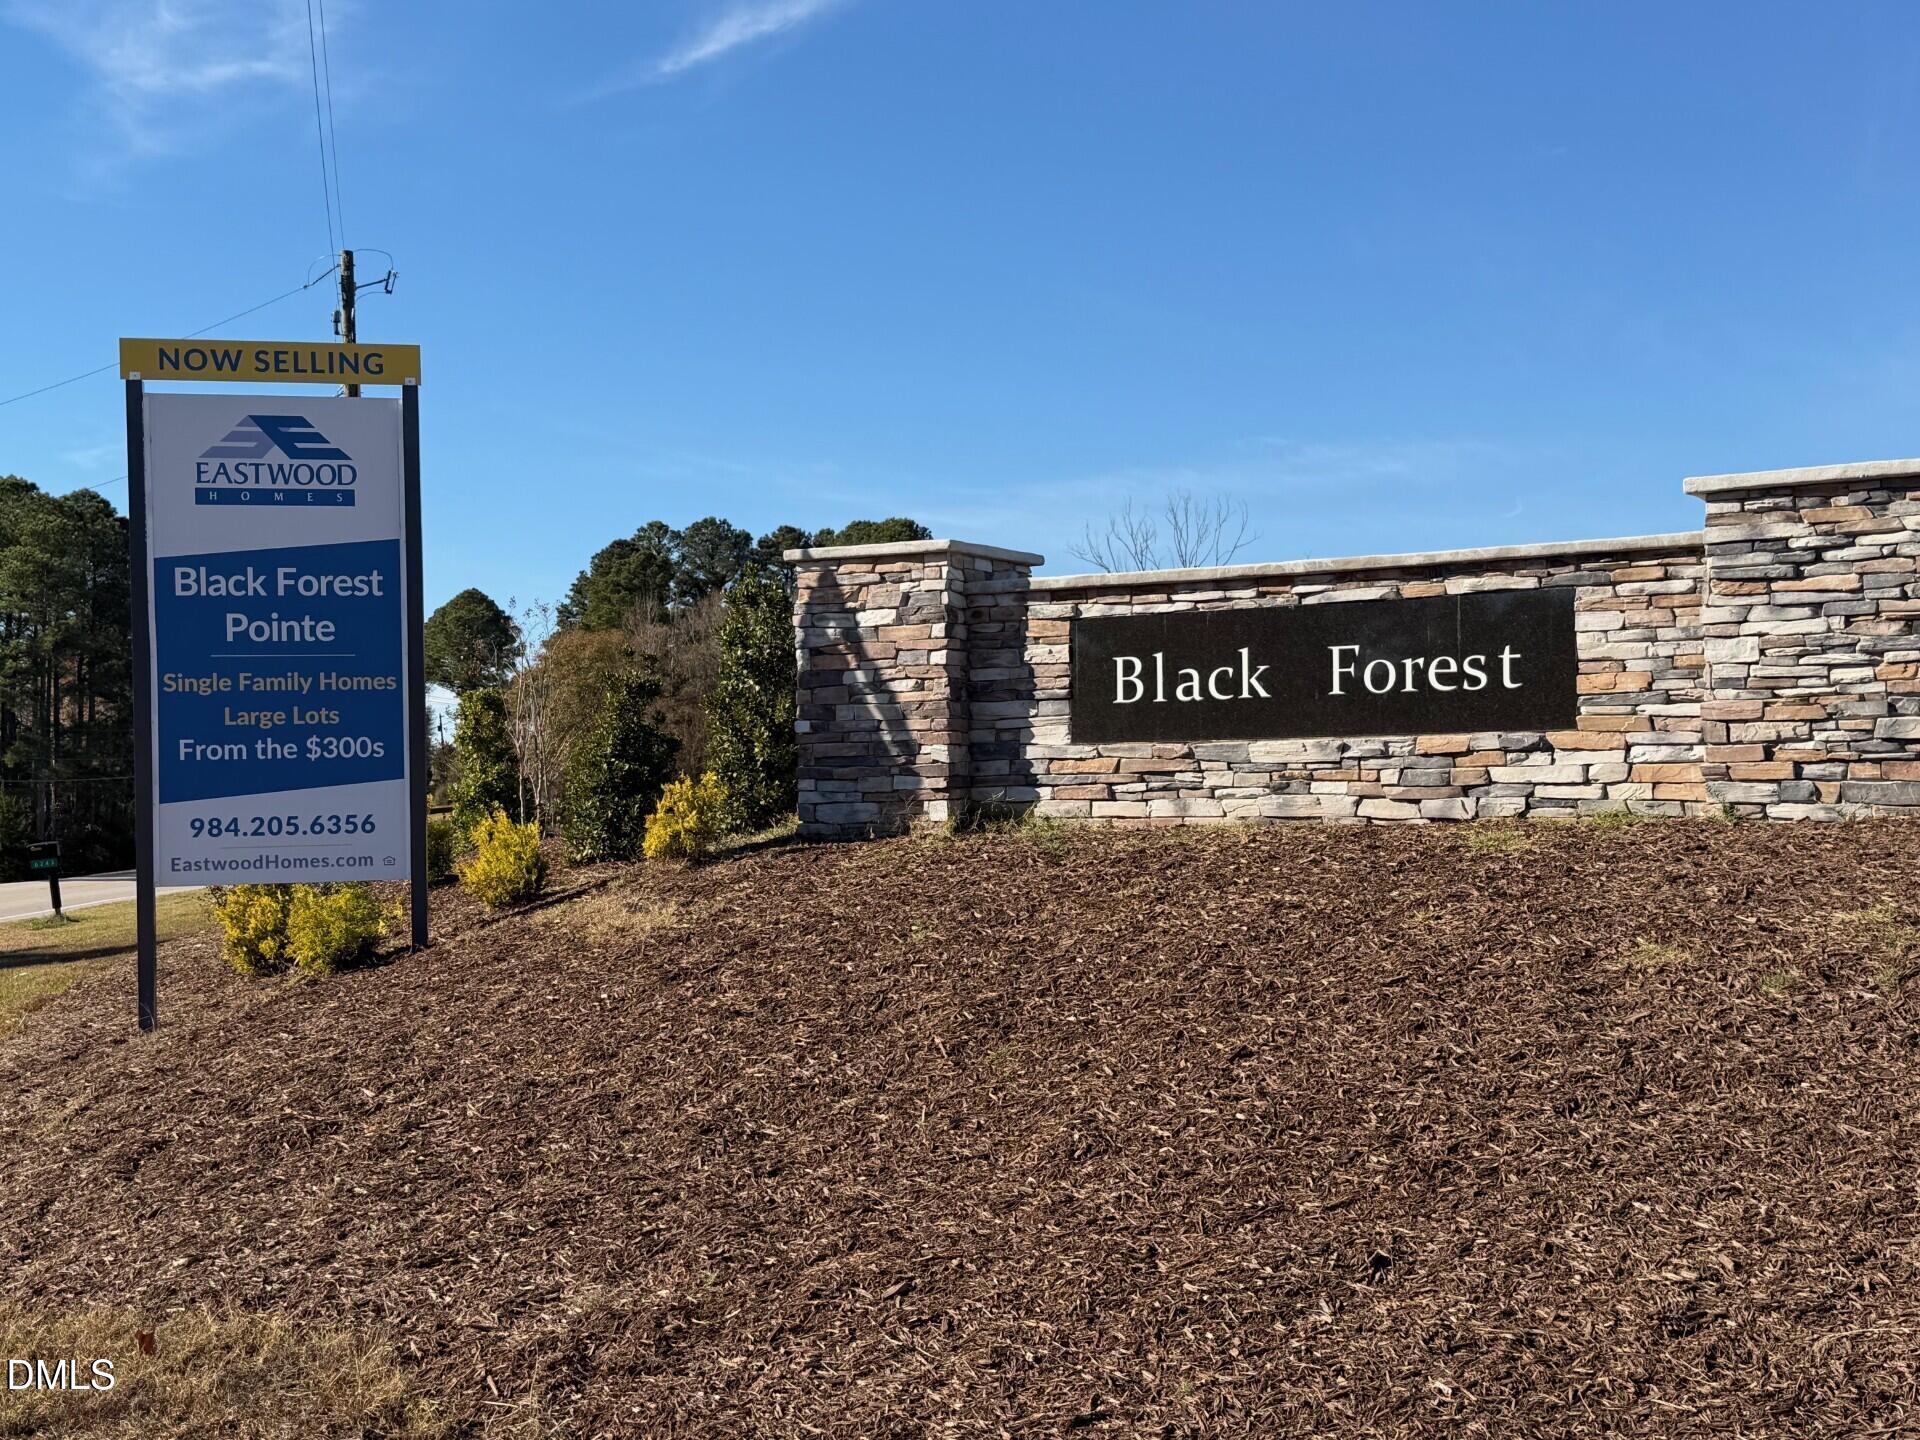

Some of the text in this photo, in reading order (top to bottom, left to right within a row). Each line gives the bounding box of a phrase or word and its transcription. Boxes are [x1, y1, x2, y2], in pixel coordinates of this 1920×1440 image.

[158, 347, 385, 375] NOW SELLING
[195, 462, 358, 486] EASTWOOD
[209, 491, 343, 502] HOMES
[174, 566, 384, 597] Black Forest
[225, 612, 336, 642] Pointe
[162, 672, 397, 696] Single Family Homes
[1112, 644, 1524, 705] Black Forest
[224, 706, 340, 729] Large Lots
[179, 734, 385, 762] From the $300s
[189, 814, 376, 838] 984.205.6356
[170, 855, 374, 872] EastwoodHomes.com
